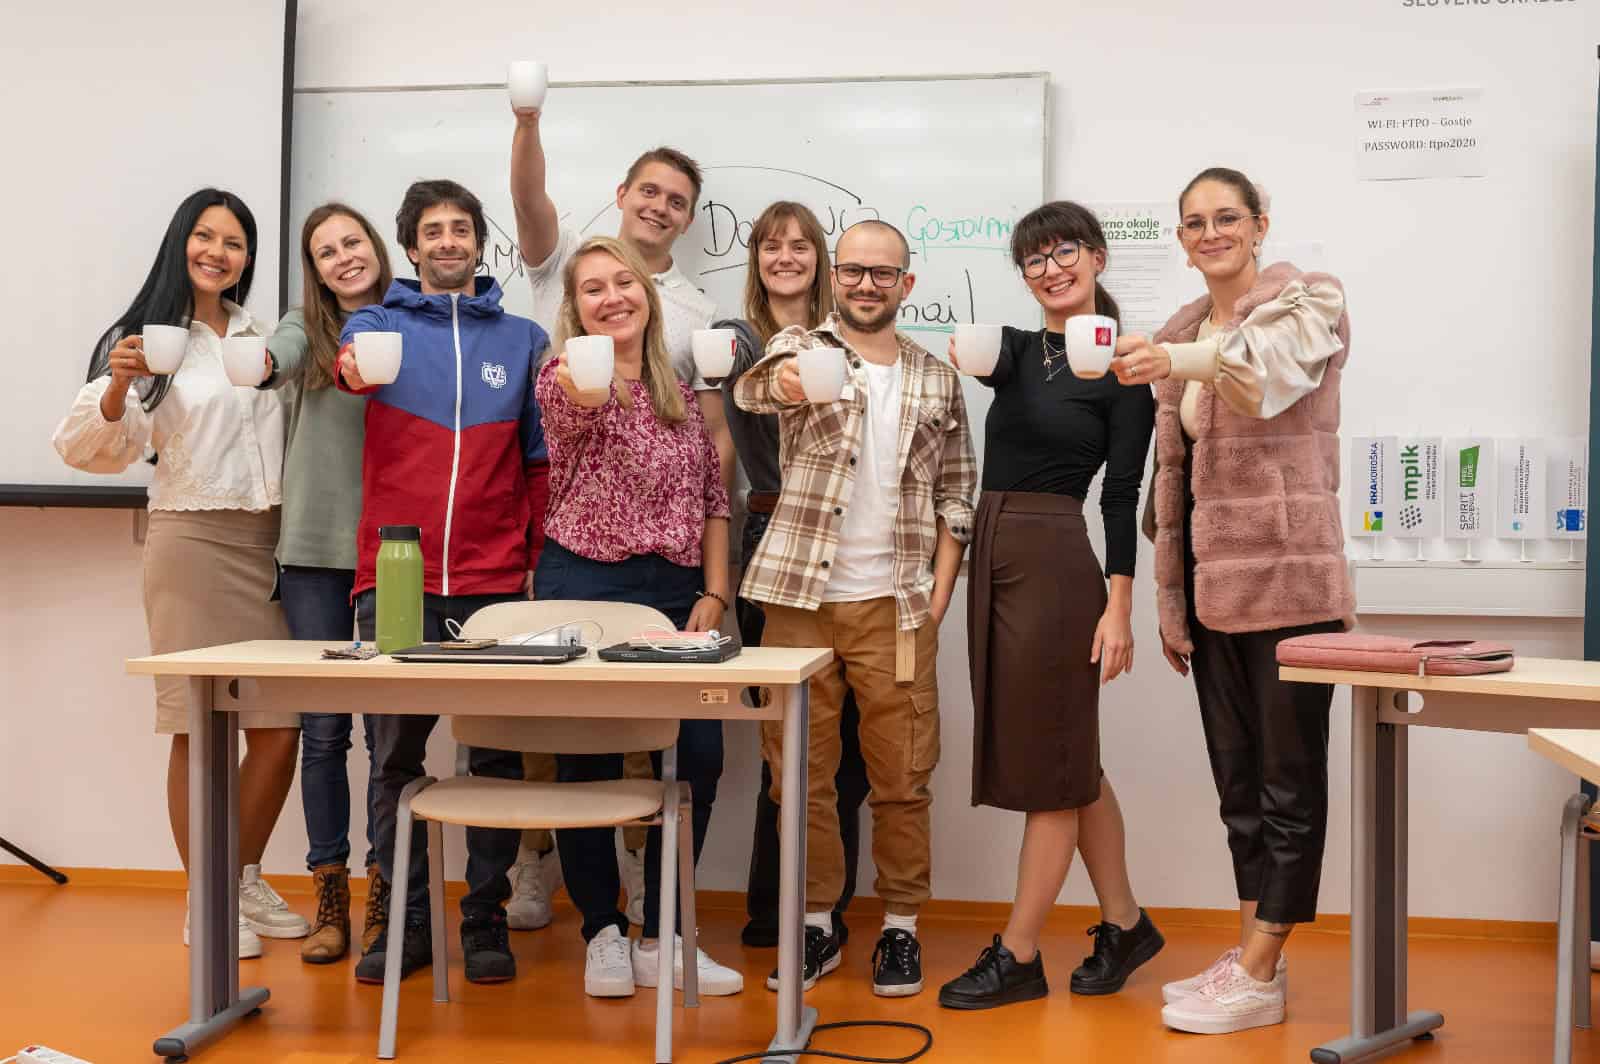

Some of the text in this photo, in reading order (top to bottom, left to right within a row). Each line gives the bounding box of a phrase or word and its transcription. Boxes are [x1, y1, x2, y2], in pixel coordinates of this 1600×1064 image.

[1402, 118, 1430, 128] FTPO
[1364, 140, 1427, 152] PASSWORD:
[1126, 218, 1160, 230] okolje
[1400, 444, 1423, 501] mpik
[1459, 491, 1469, 530] SPIRIT
